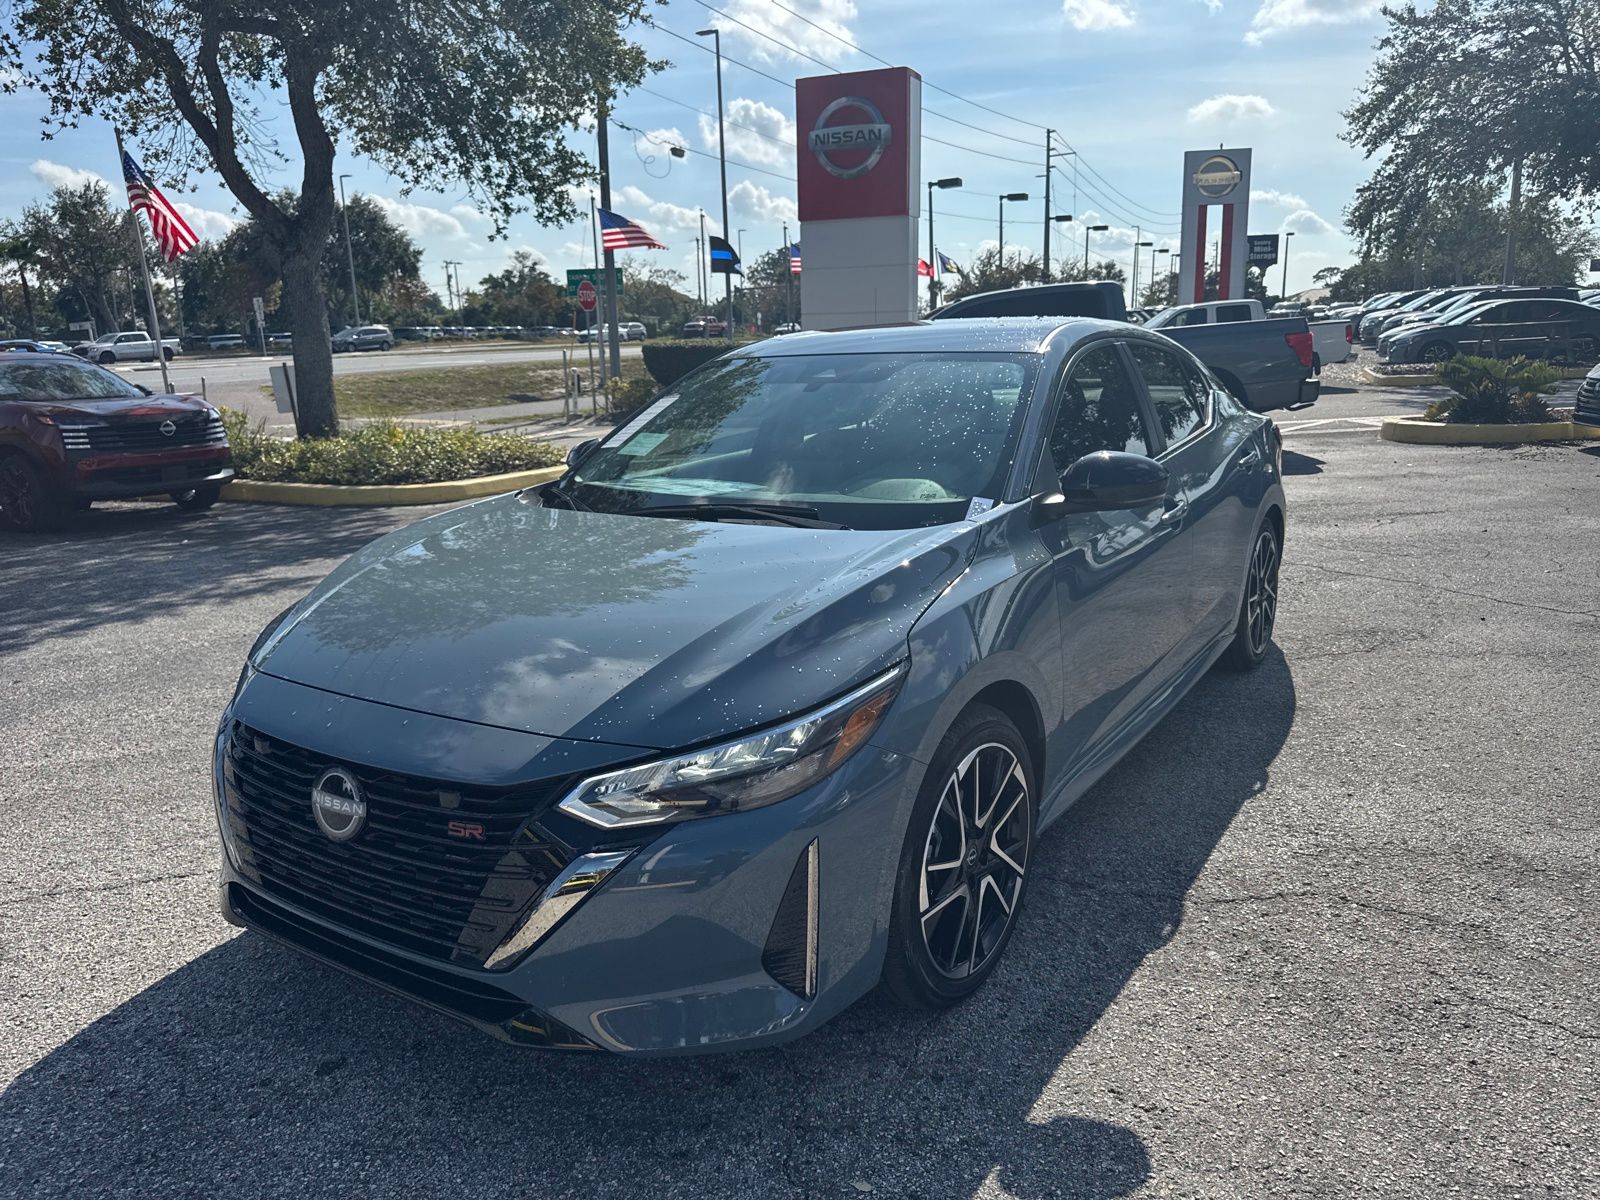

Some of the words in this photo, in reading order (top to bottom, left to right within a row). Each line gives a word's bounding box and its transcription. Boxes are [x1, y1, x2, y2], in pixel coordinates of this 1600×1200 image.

[814, 128, 882, 146] NISSAN
[1249, 252, 1276, 260] Storage
[579, 290, 596, 302] STOP
[312, 790, 363, 815] NISSAN
[447, 821, 485, 839] SR
